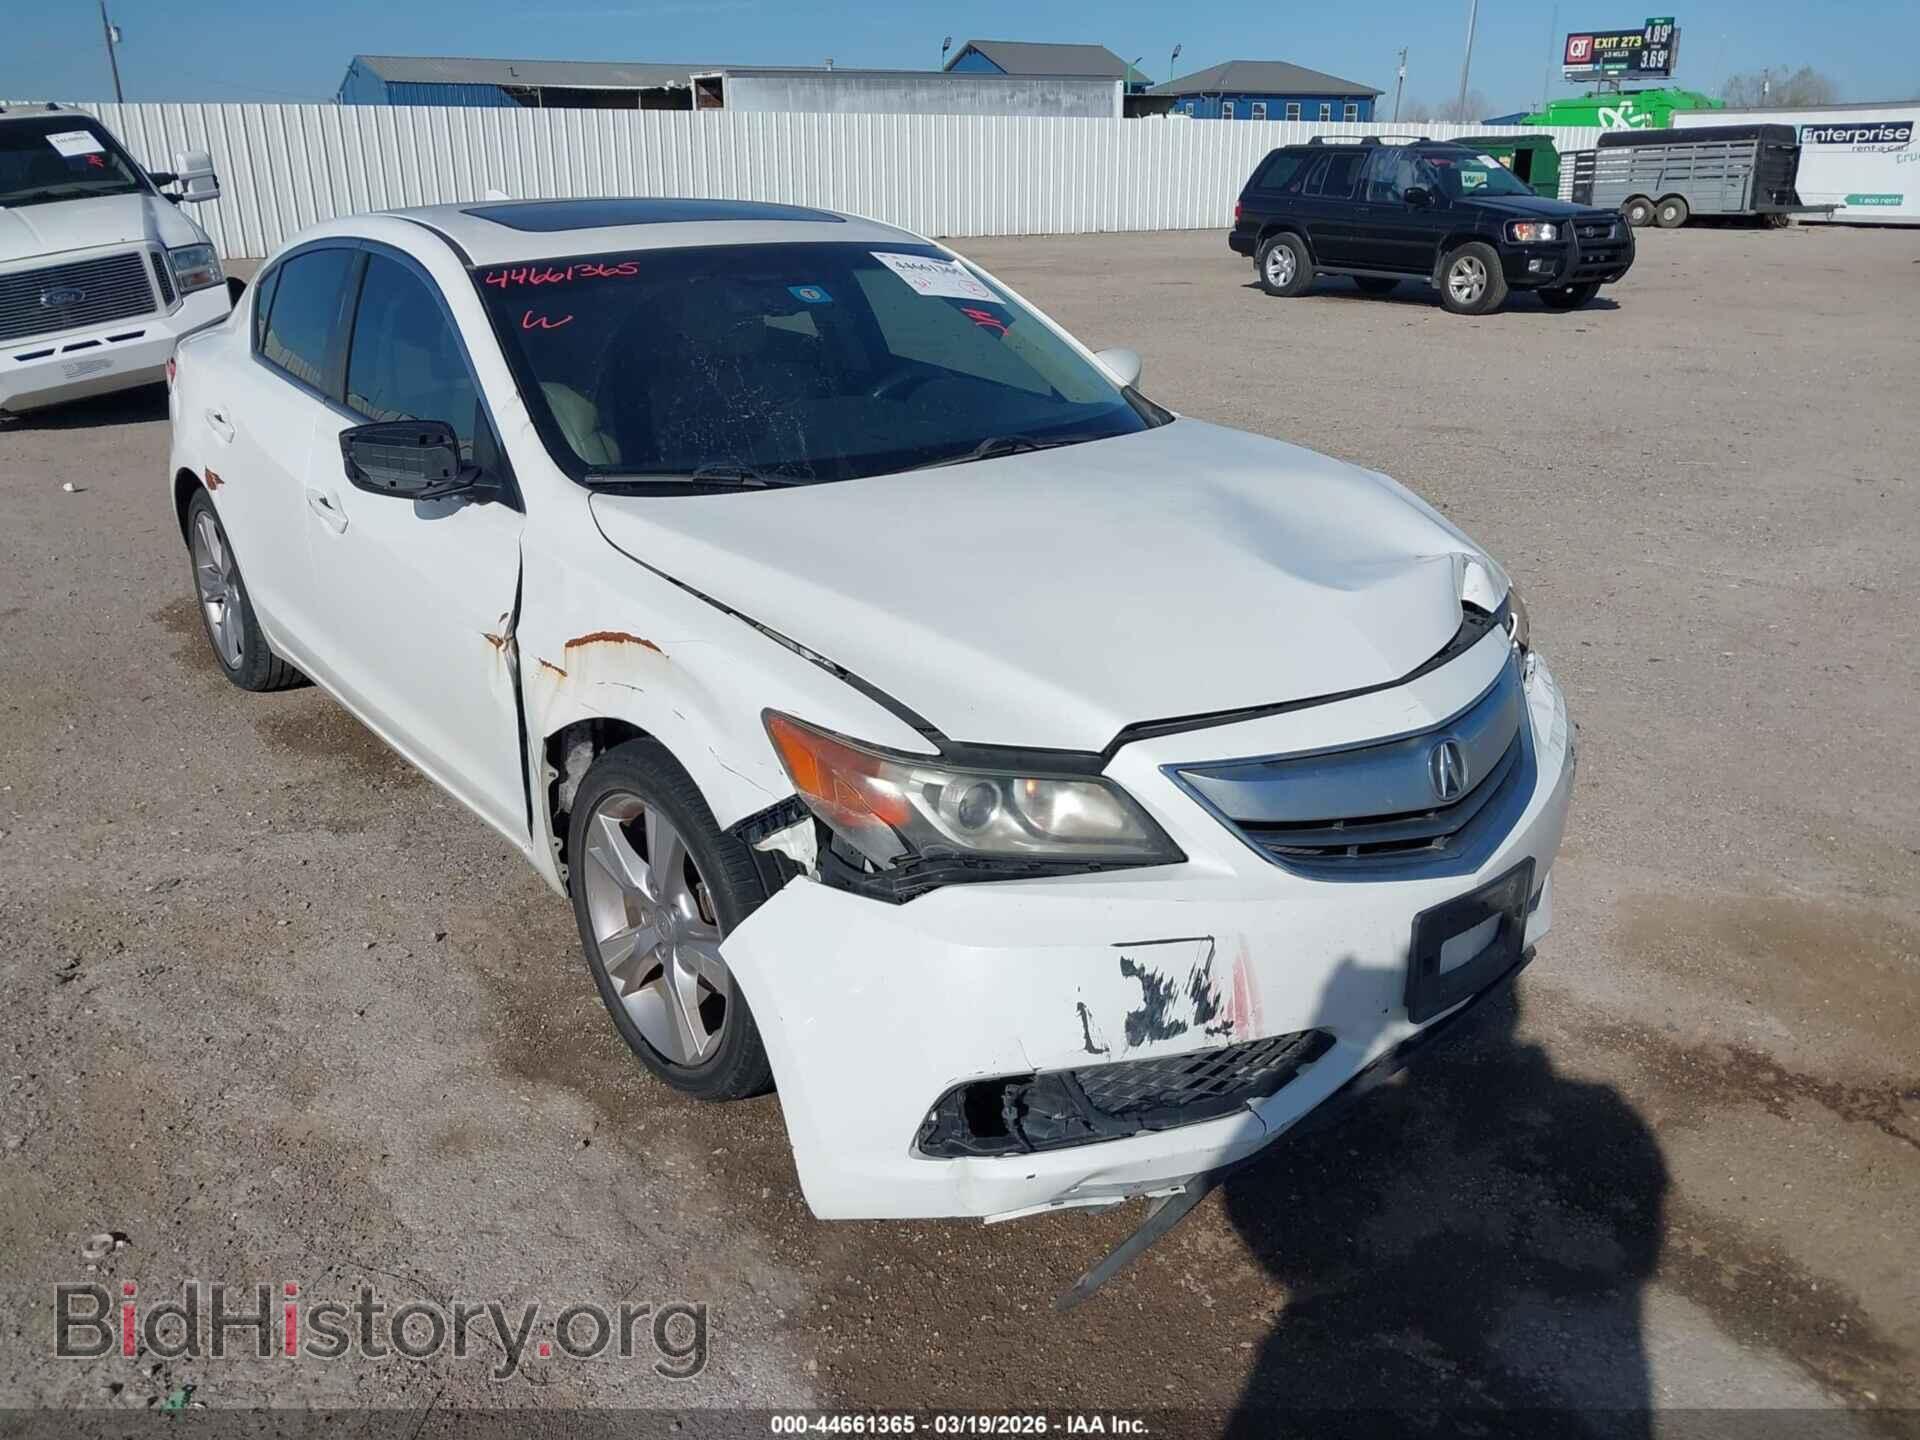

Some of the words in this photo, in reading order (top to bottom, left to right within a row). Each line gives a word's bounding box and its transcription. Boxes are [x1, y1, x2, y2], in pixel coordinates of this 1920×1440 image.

[1570, 39, 1588, 56] QT
[1594, 38, 1618, 48] EXIT
[1621, 36, 1642, 47] 273
[1801, 124, 1909, 144] Enterprise
[485, 261, 640, 288] 44661365
